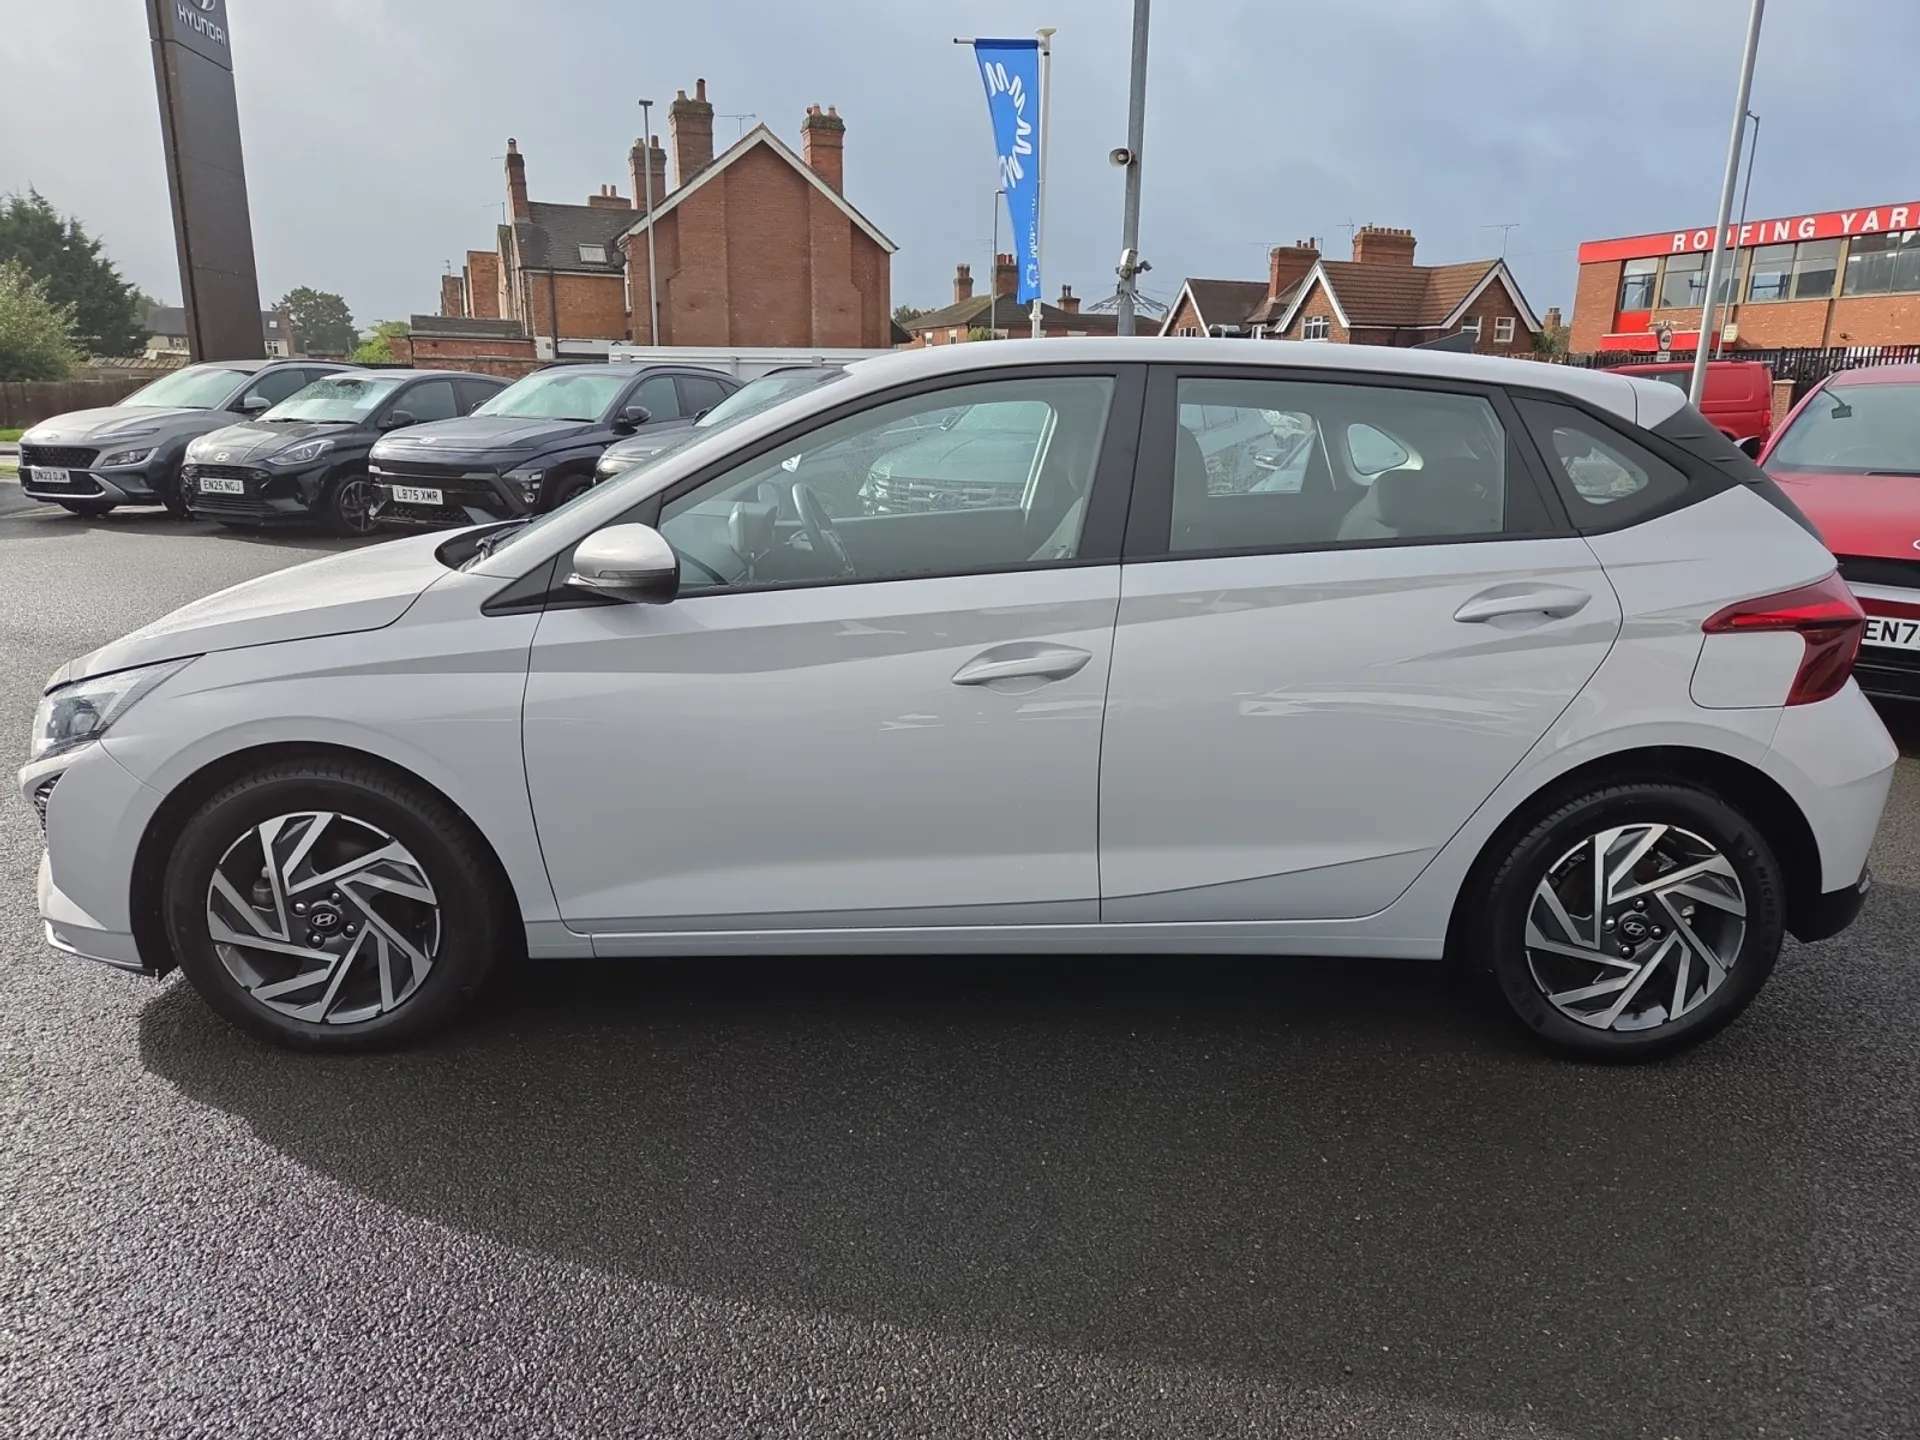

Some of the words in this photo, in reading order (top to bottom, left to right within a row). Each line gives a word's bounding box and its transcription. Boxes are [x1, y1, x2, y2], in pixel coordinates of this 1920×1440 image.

[177, 4, 227, 46] HYUNDAI
[1672, 217, 1816, 252] ROFING
[1840, 206, 1920, 234] YAR
